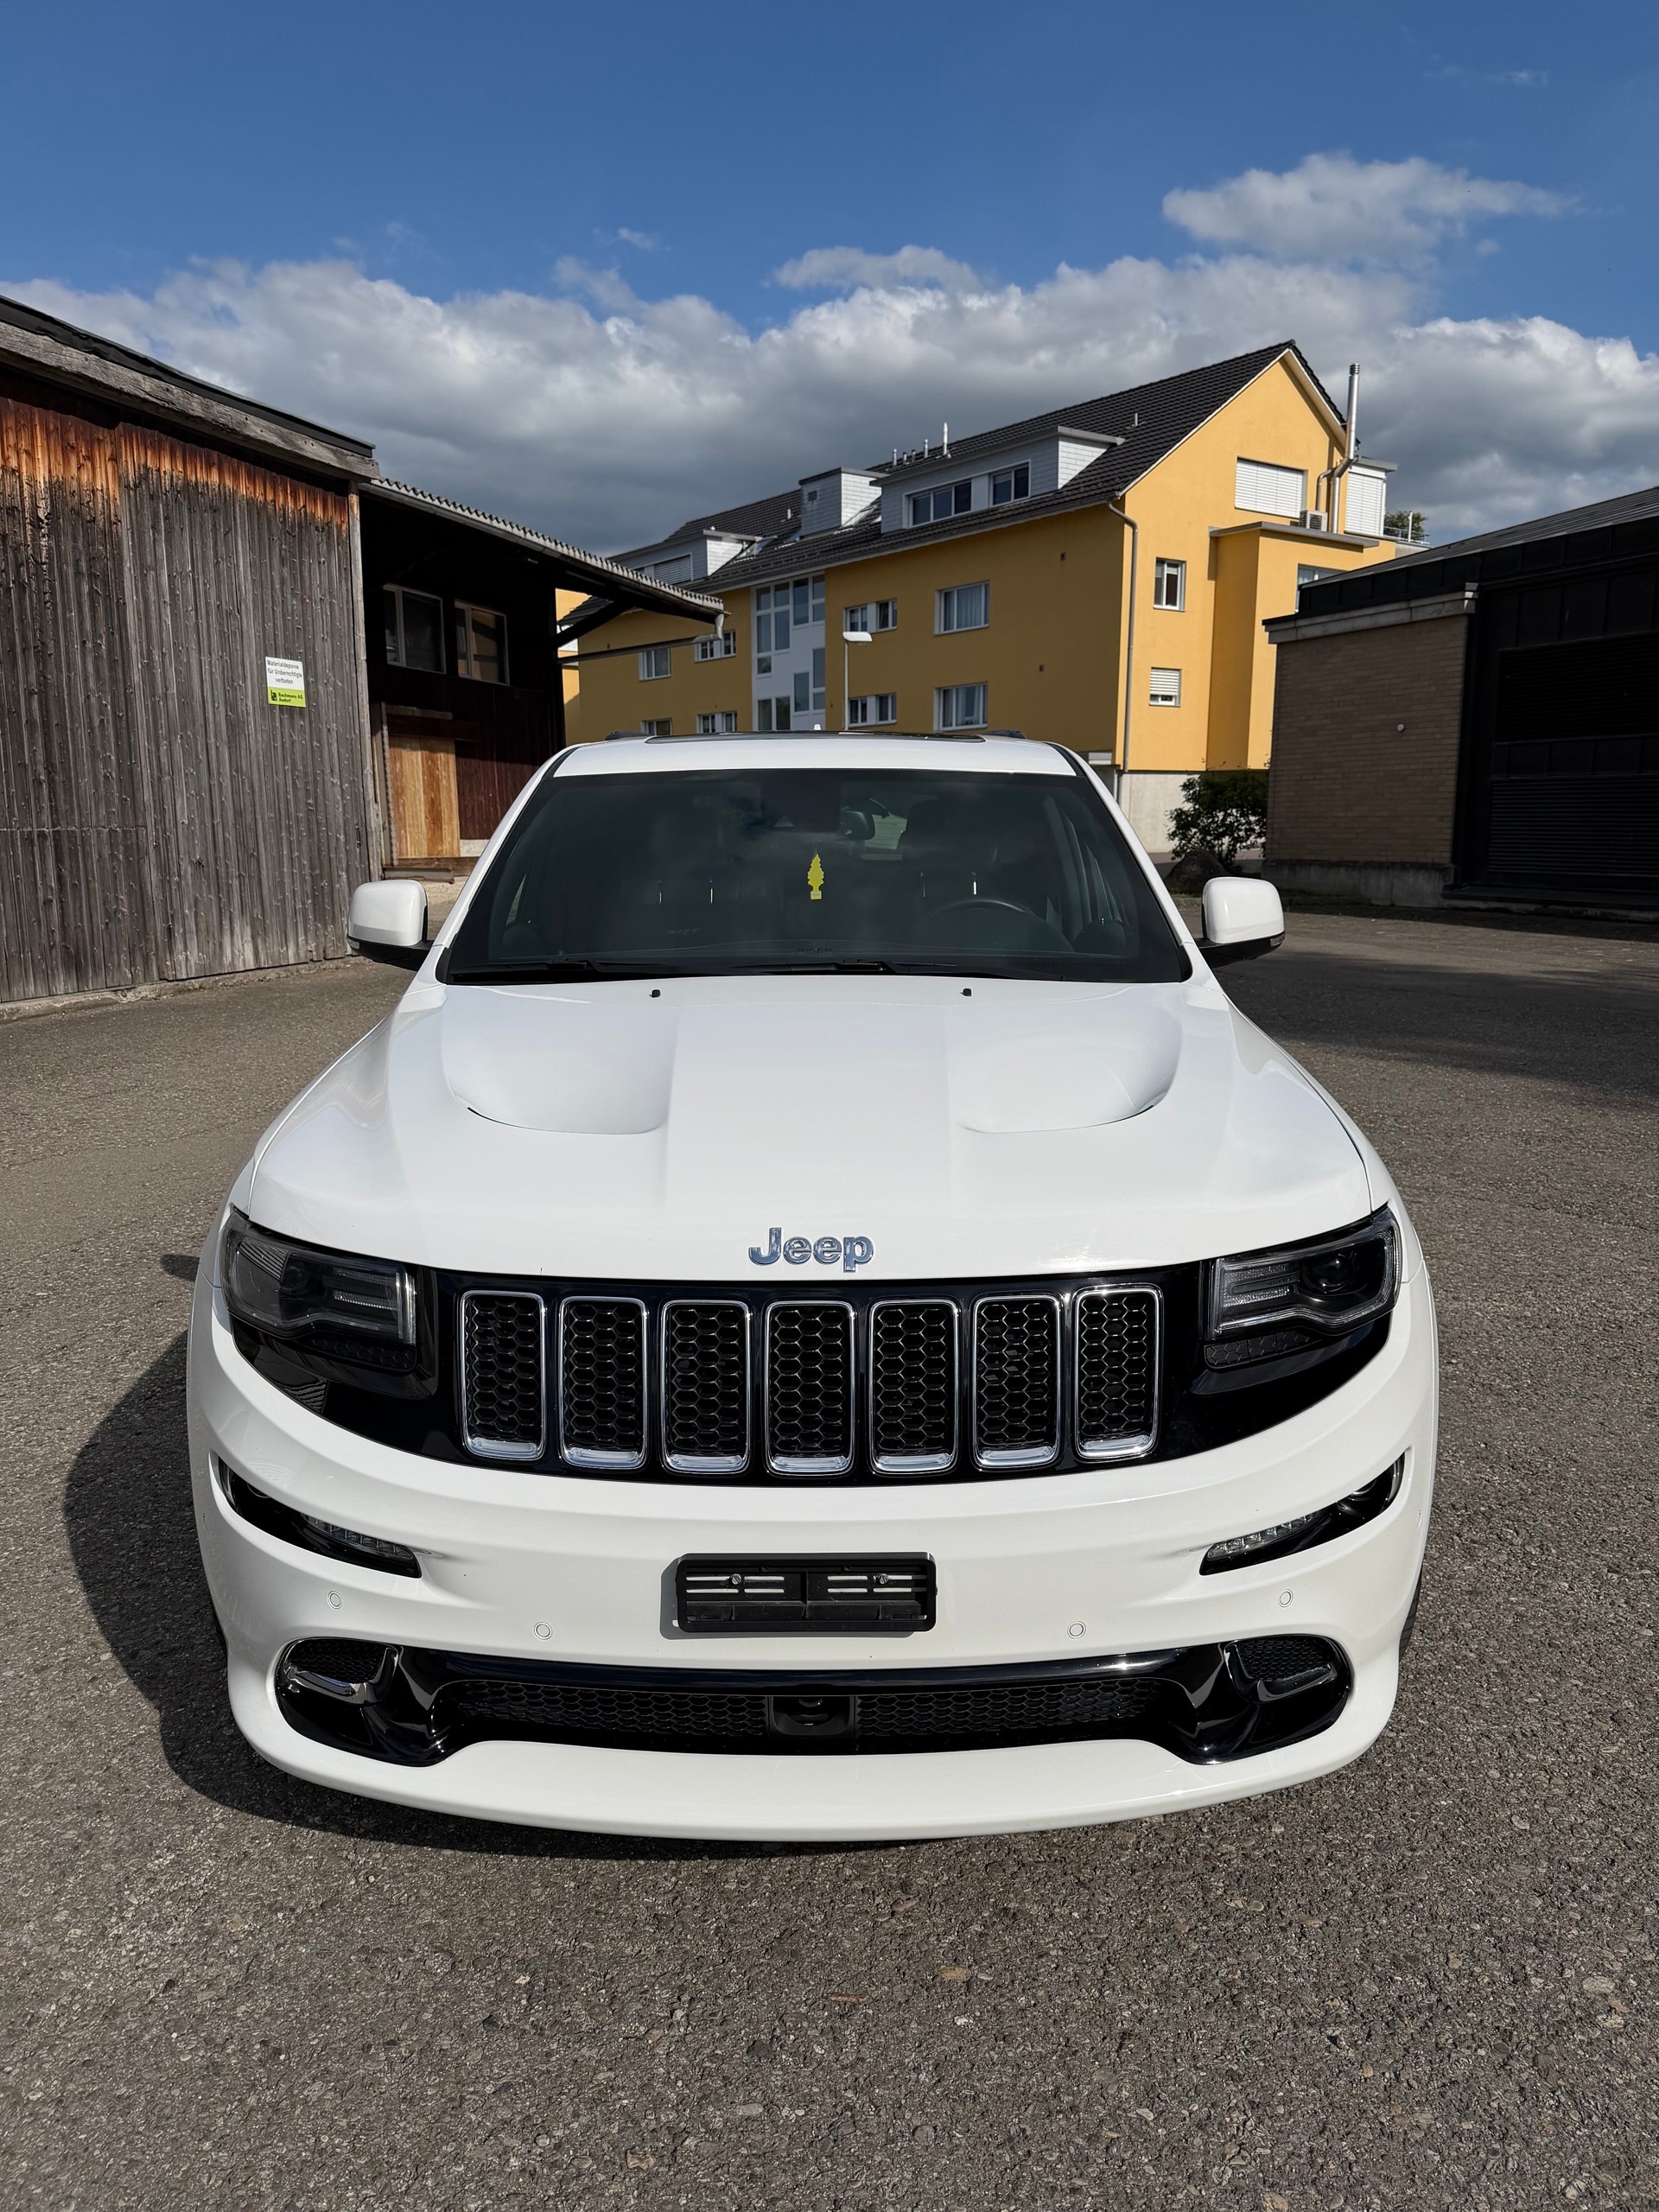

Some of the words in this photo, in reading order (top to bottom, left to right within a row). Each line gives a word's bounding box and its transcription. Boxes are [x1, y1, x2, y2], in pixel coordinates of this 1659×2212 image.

[267, 659, 299, 670] Materialdeponie
[274, 668, 302, 678] Unberechtigte
[748, 1227, 874, 1273] Jeep
